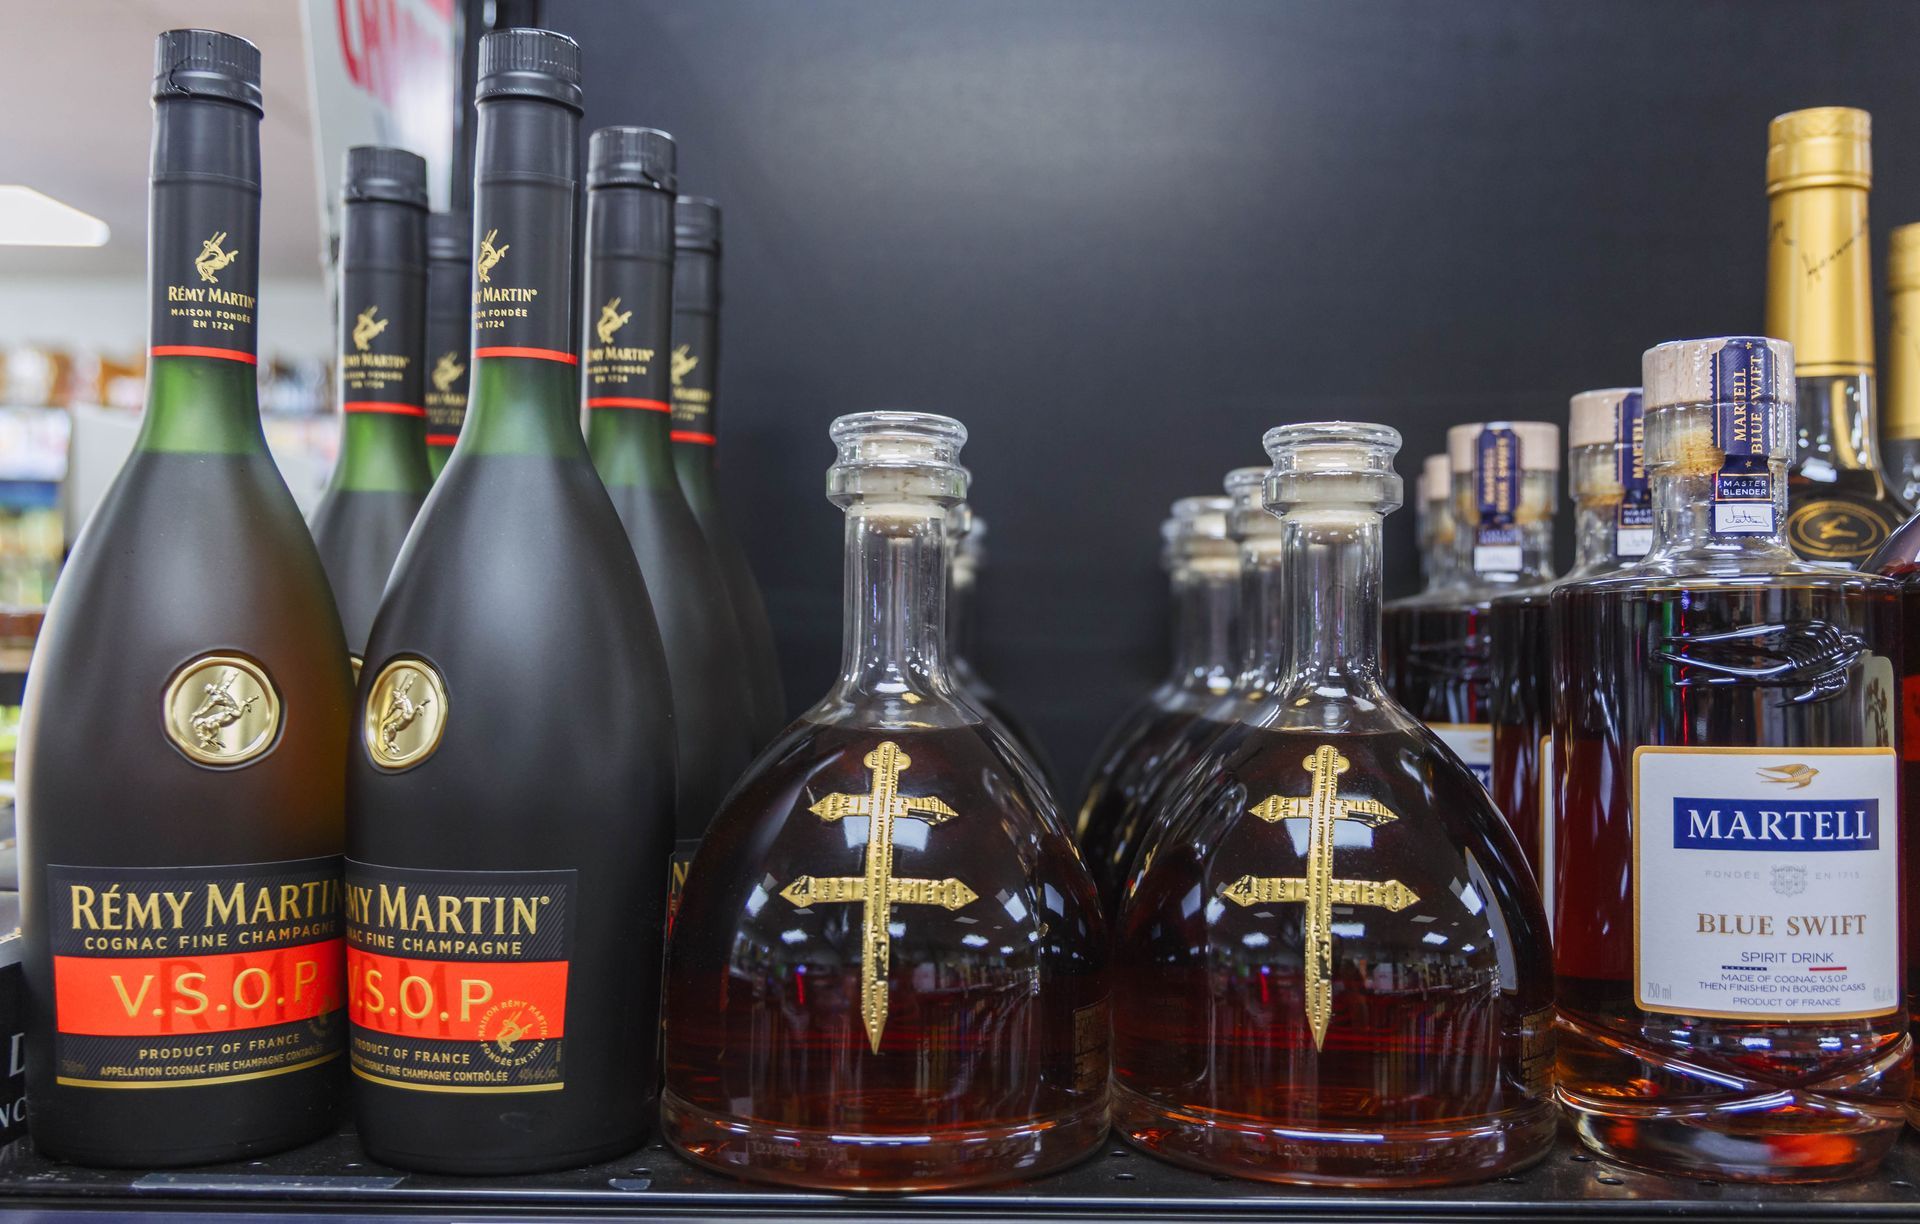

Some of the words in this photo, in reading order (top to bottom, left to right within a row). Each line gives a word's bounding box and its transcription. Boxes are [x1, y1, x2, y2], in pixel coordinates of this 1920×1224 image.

[168, 285, 205, 302] RÉMY
[171, 309, 212, 318] MAISON
[216, 310, 251, 324] FONDÉE
[488, 308, 528, 318] FONDÉE
[192, 319, 207, 329] EN
[212, 321, 235, 331] 1724
[485, 320, 505, 329] 1724
[1733, 367, 1747, 443] MARTELL
[1751, 411, 1763, 455] BLUE
[1722, 488, 1767, 496] BLENDER
[1687, 809, 1872, 840] MARTELL
[1815, 872, 1832, 880] EN
[71, 884, 193, 931] RÉMY
[1696, 912, 1774, 936] BLUE
[1786, 913, 1867, 937] SWIFT
[84, 937, 168, 951] COGNAC
[179, 933, 228, 949] FINE
[238, 919, 336, 945] CHAMPAGNE
[366, 932, 395, 949] FINE
[402, 937, 523, 955] CHAMPAGNE
[1741, 951, 1787, 964] SPIRIT
[1792, 952, 1834, 964] DRINK
[1699, 981, 1727, 991] THEN
[1729, 983, 1778, 993] FINISHED
[1780, 985, 1790, 993] IN
[1793, 985, 1839, 994] BOURBON
[1841, 982, 1866, 993] CASKS
[1721, 974, 1754, 983] MADE
[1757, 975, 1772, 983] OF
[1774, 975, 1817, 984] COGNAC
[110, 960, 318, 1017] V.S.O.P
[1732, 997, 1781, 1007] PRODUCT
[1785, 998, 1799, 1007] OF
[1801, 998, 1841, 1007] FRANCE
[478, 1005, 500, 1037] MAISON
[528, 1005, 549, 1036] MARTIN
[139, 1045, 214, 1060] PRODUCT
[221, 1042, 241, 1054] OF
[249, 1033, 300, 1051] FRANCE
[480, 1042, 513, 1067] FONDÉE
[514, 1056, 528, 1067] EN
[101, 1066, 162, 1077] APPELLATION
[165, 1064, 206, 1076] COGNAC
[208, 1061, 230, 1073] FINE
[232, 1053, 285, 1070] CHAMPAGNE
[394, 1048, 409, 1060] OF
[415, 1051, 471, 1065] FRANCE
[385, 1064, 401, 1076] FINE
[402, 1067, 451, 1082] CHAMPAGNE
[453, 1069, 509, 1082] CONTRÔLÉE
